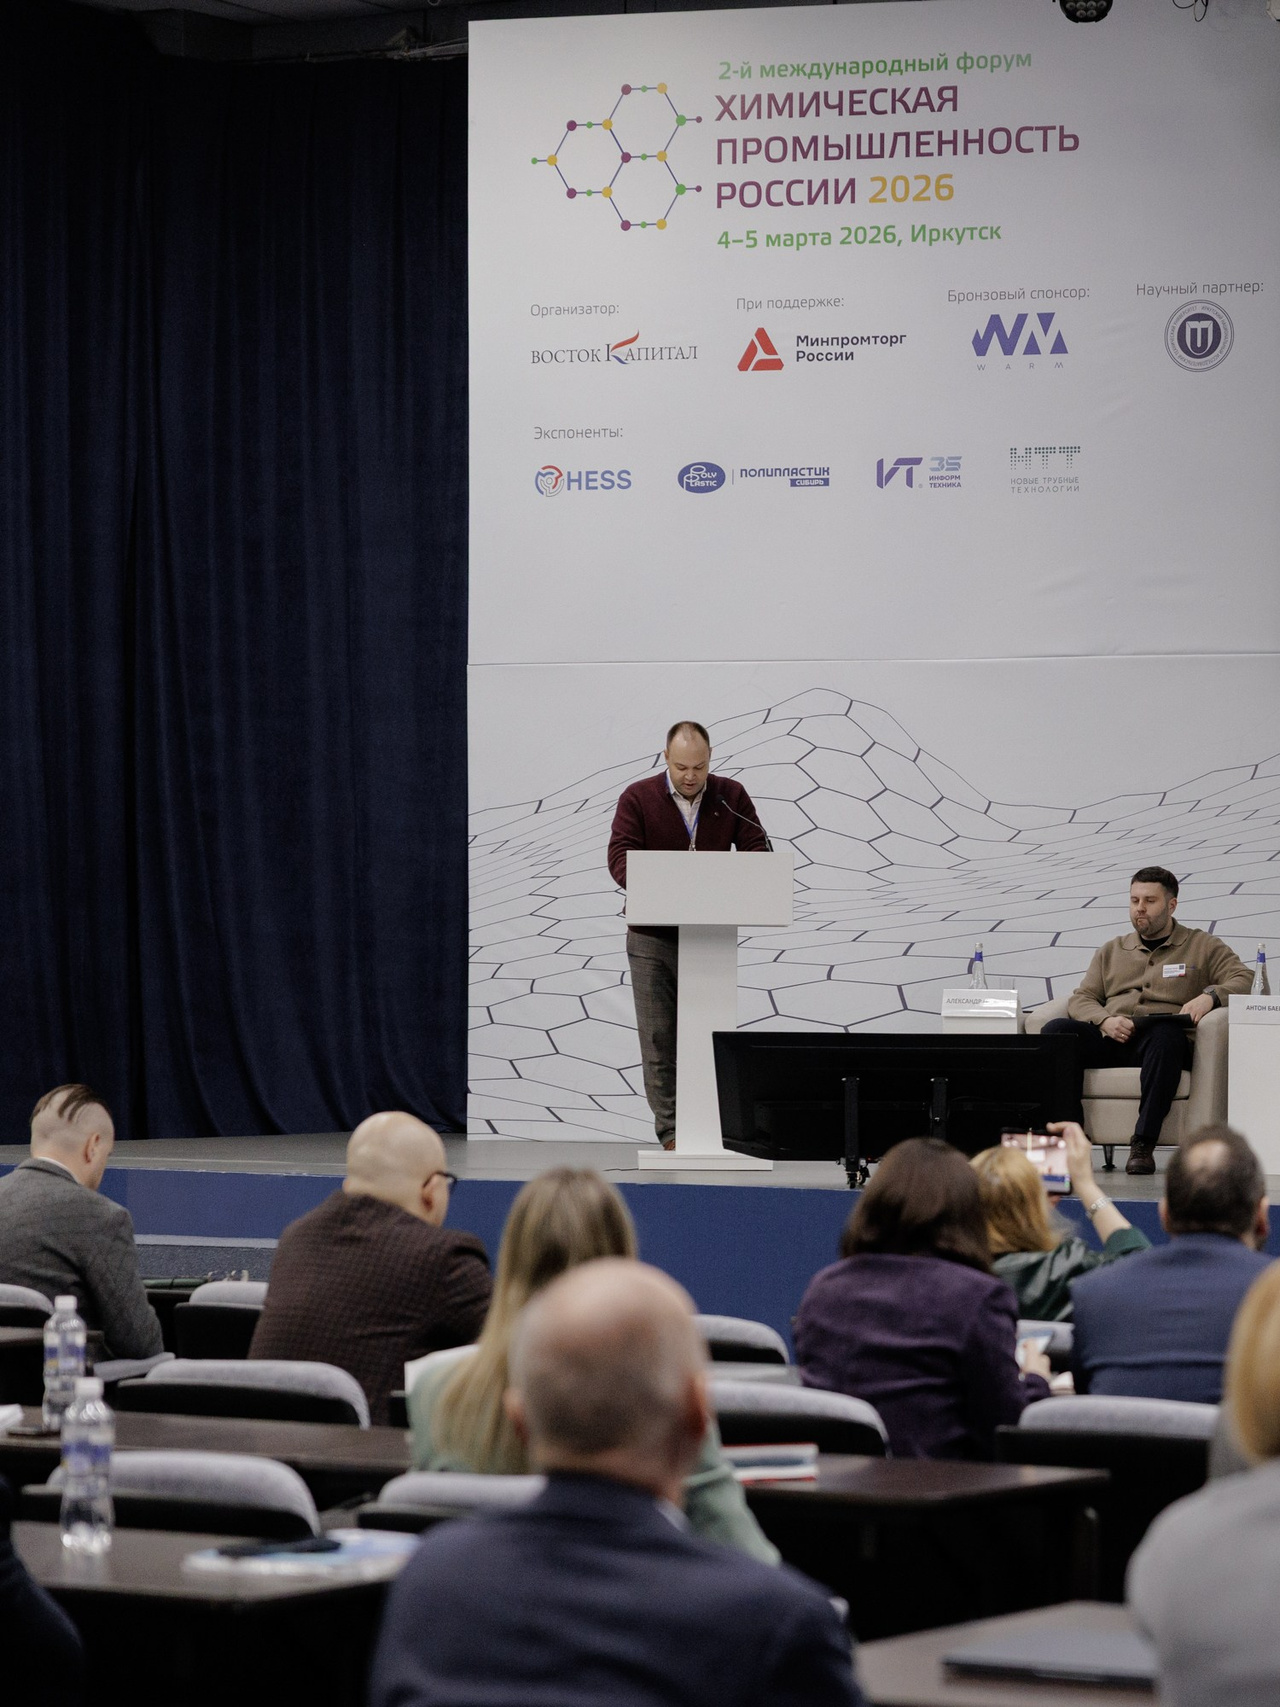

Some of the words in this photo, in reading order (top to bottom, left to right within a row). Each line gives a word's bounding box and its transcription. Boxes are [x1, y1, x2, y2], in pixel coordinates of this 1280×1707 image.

[719, 59, 751, 79] 2-й
[760, 52, 948, 80] международный
[956, 50, 1031, 74] форум
[715, 84, 957, 121] ХИМИЧЕСКАЯ
[716, 124, 1079, 164] ПРОМЫШЛЕННОСТЬ
[716, 177, 855, 208] РОССИИ
[868, 173, 954, 203] 2026
[765, 231, 831, 250] марта
[839, 224, 902, 246] 2026,
[910, 223, 1001, 246] Иркутск
[947, 287, 1025, 304] Бронзовый
[1029, 287, 1089, 300] спонсор:
[1136, 281, 1197, 298] Научный
[1202, 282, 1263, 295] партнер:
[530, 303, 619, 318] Организатор:
[736, 297, 762, 312] При
[766, 297, 844, 310] поддержке:
[796, 334, 906, 348] Минпромторг
[531, 348, 600, 363] ВОСТОК
[796, 350, 853, 362] России
[533, 426, 622, 439] Экспоненты:
[740, 466, 829, 477] ПОЛИПЛАСТИК
[567, 469, 631, 490] HESS
[795, 478, 824, 486] СИБИРЬ
[1010, 477, 1038, 485] НОВЫЕ
[1042, 475, 1079, 484] ТРУБНЫЕ
[1010, 485, 1079, 493] ТЕХНОЛОГИИ
